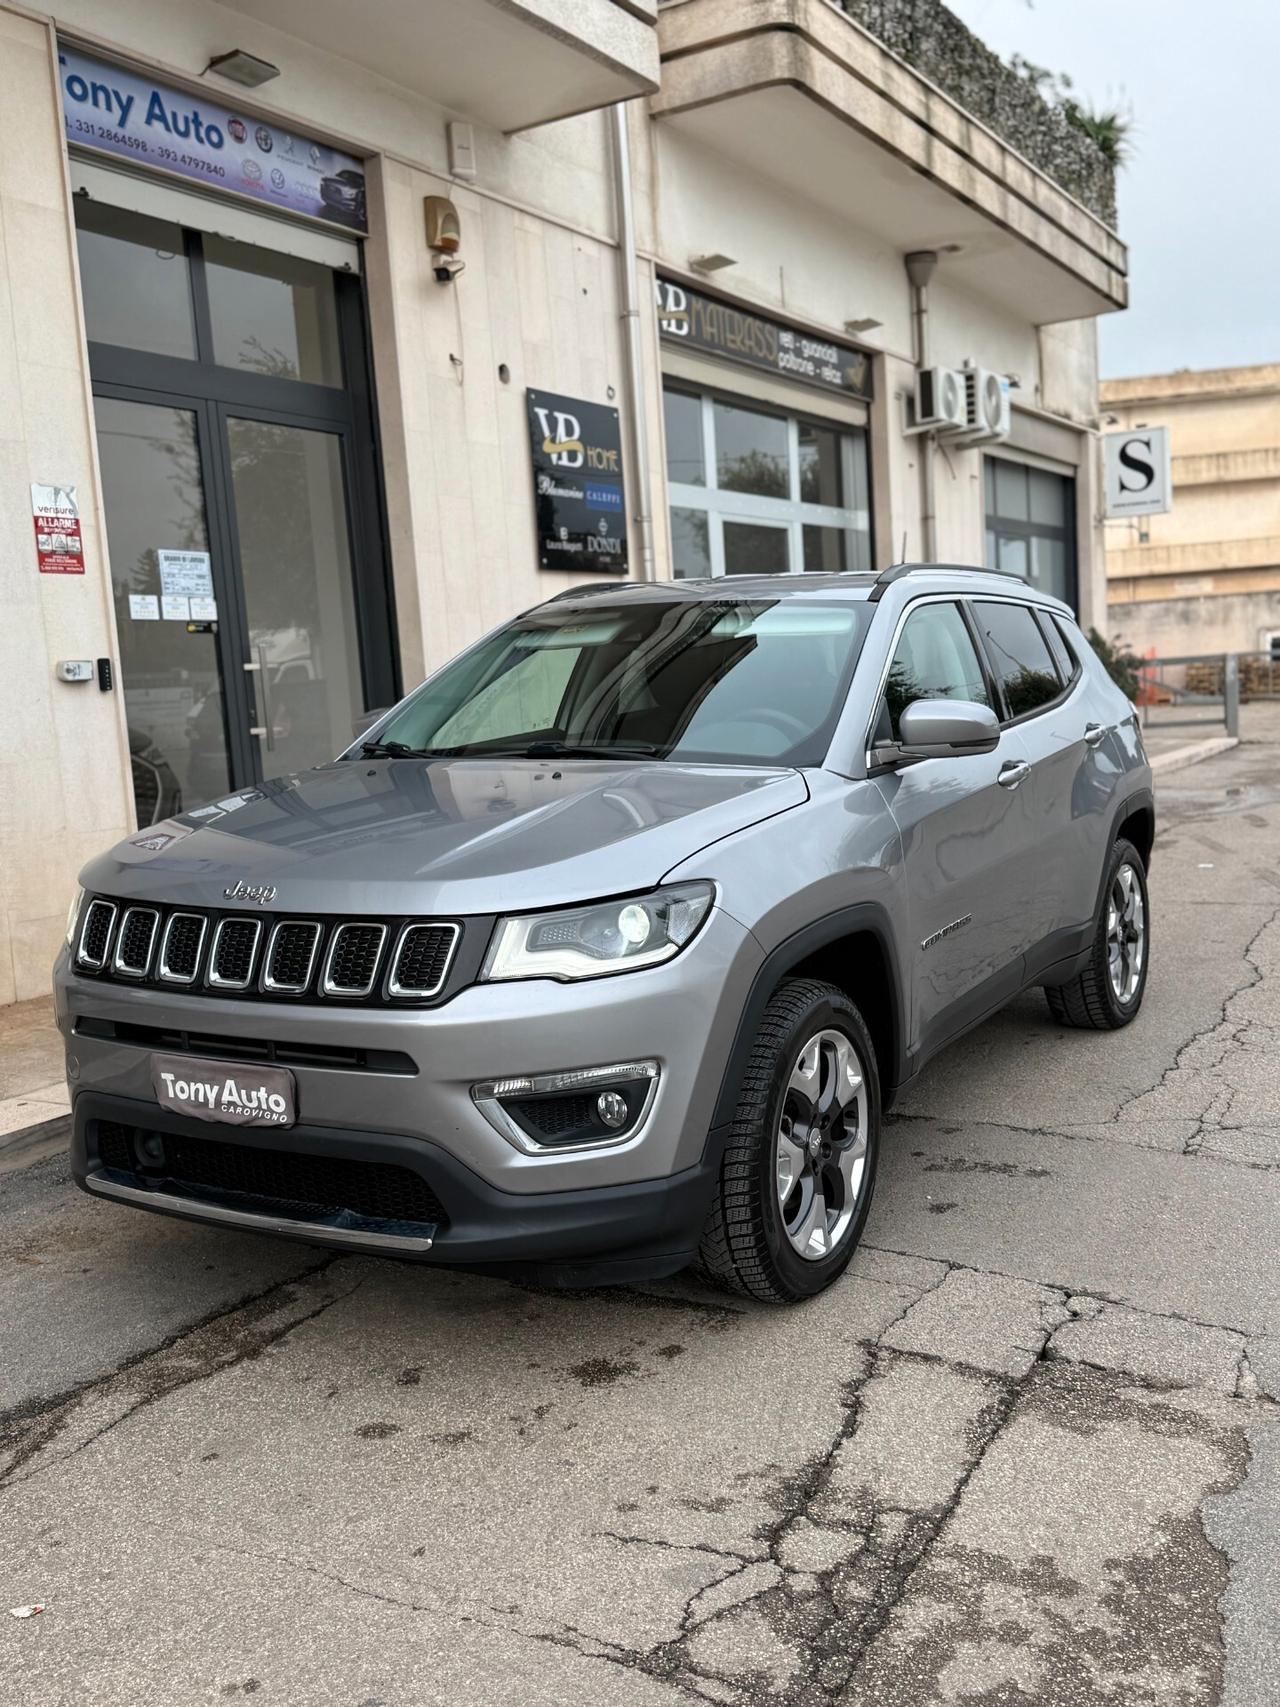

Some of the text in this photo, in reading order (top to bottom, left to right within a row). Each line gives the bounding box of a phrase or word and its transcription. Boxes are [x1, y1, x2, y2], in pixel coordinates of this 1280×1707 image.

[144, 90, 224, 149] Auto
[76, 119, 95, 135] 331
[99, 127, 148, 152] 2864598
[157, 147, 177, 162] 393
[180, 154, 225, 178] 4797840
[691, 297, 779, 363] MATERASSI
[587, 446, 619, 472] HOME
[1118, 437, 1154, 495] S
[38, 506, 74, 515] verisure
[38, 517, 78, 529] ALLARME
[223, 880, 276, 905] Jeep
[160, 1072, 286, 1113] Tony Auto
[221, 1104, 288, 1123] CAROVIGNO
